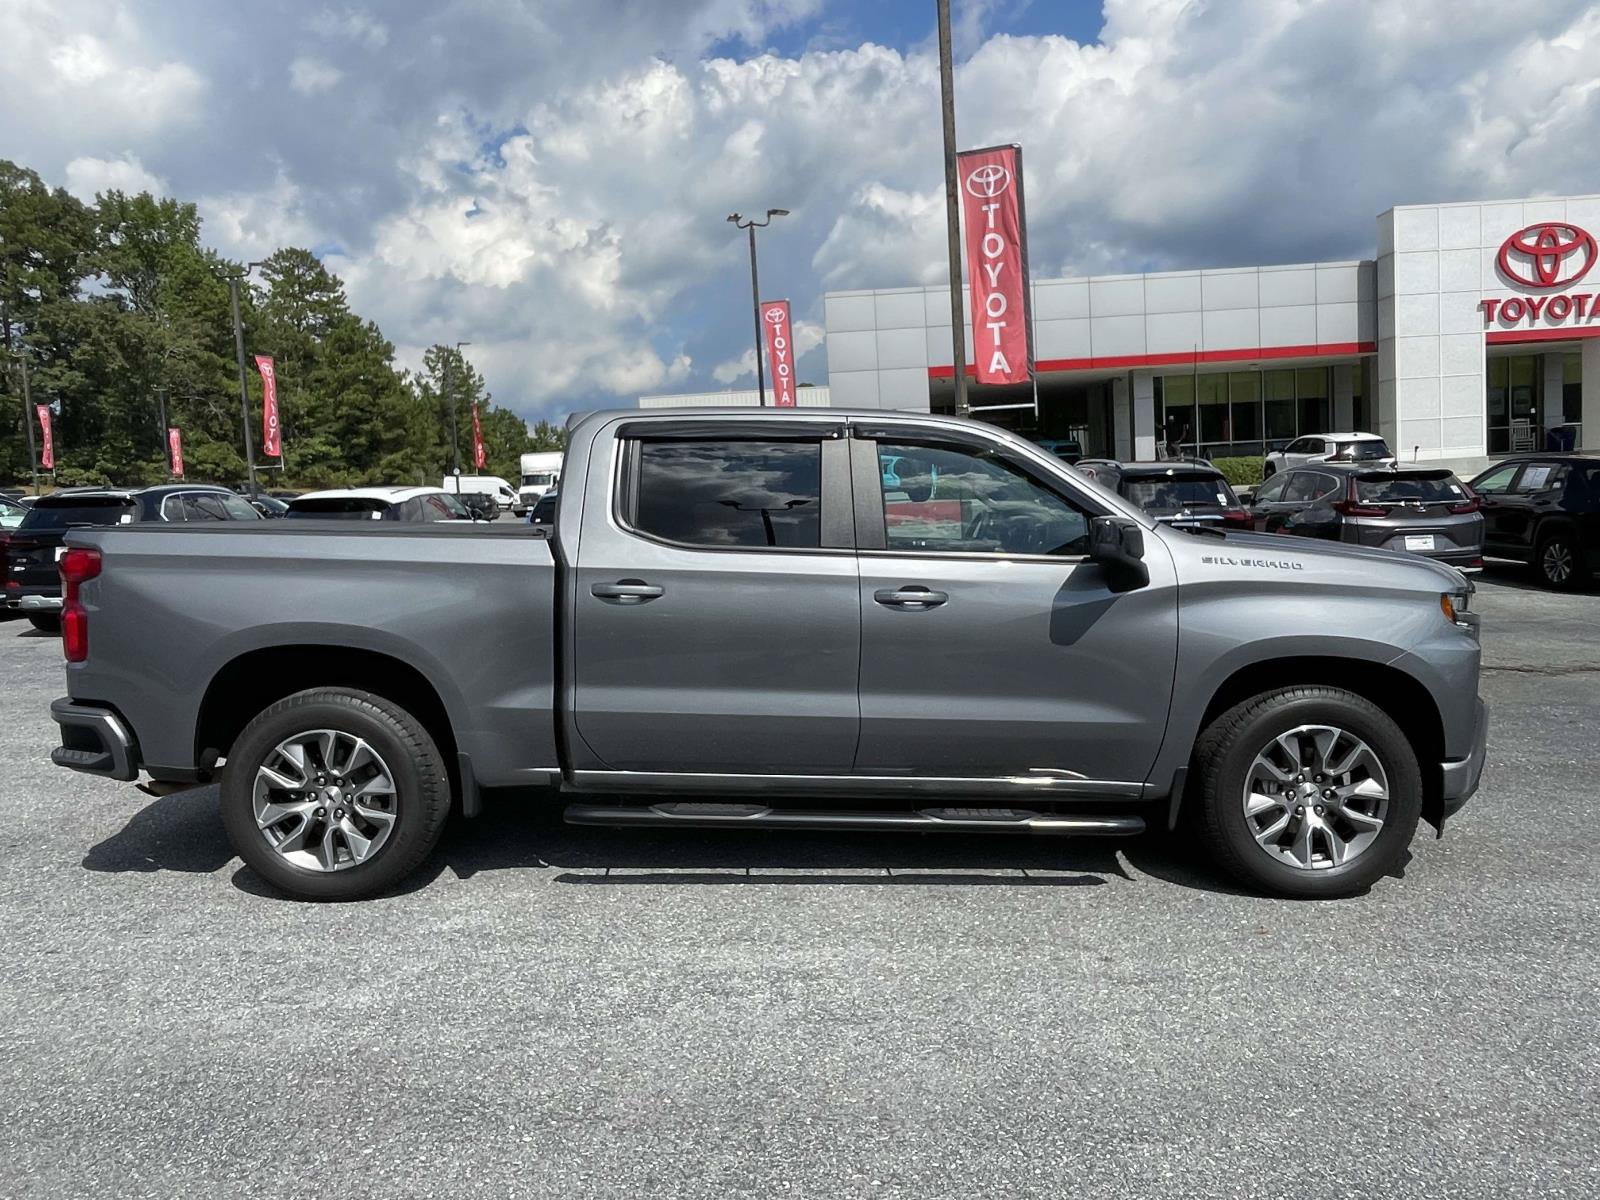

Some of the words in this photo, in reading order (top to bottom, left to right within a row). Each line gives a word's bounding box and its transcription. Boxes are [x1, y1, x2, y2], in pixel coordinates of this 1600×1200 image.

[981, 203, 1012, 374] TOYOTA
[773, 324, 790, 403] TOYOTA
[1201, 556, 1303, 570] SILVERADO
